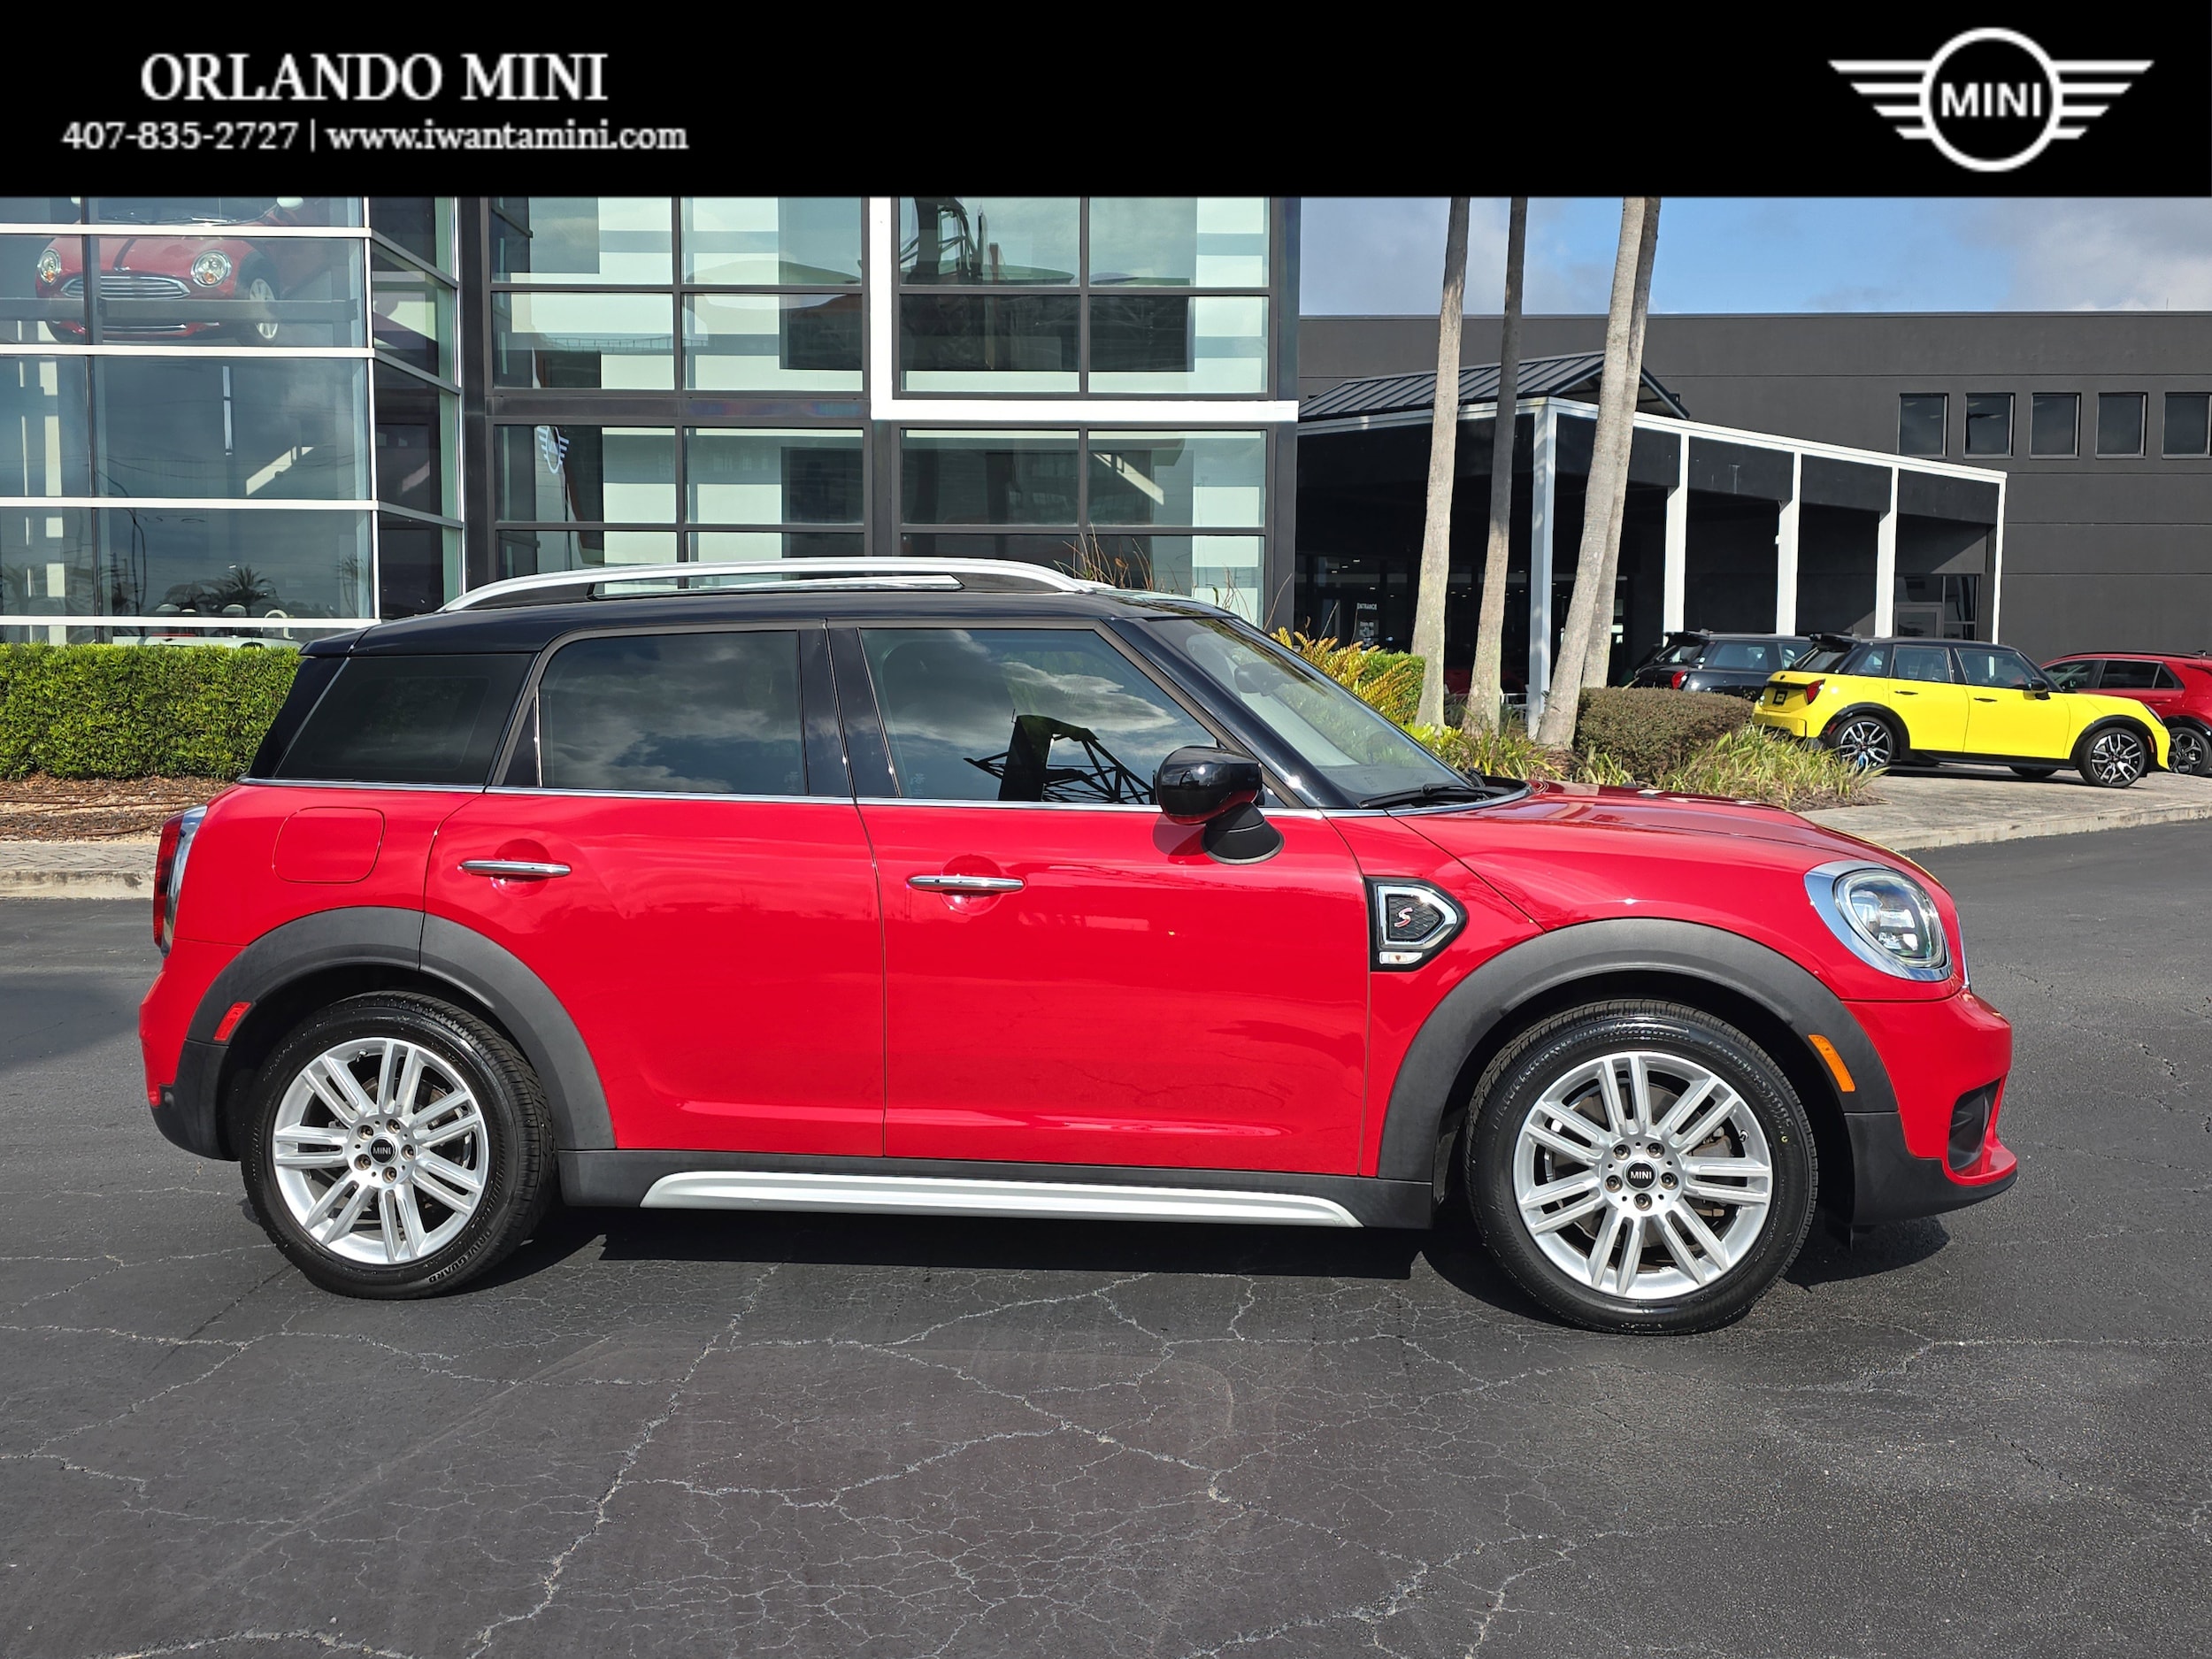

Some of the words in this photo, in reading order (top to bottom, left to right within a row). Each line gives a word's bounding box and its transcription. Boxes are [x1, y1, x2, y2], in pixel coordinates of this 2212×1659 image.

[1394, 907, 1414, 928] S
[373, 1146, 391, 1155] MINI
[1630, 1171, 1653, 1179] MINI
[427, 1227, 492, 1284] DRIVEGUARD
